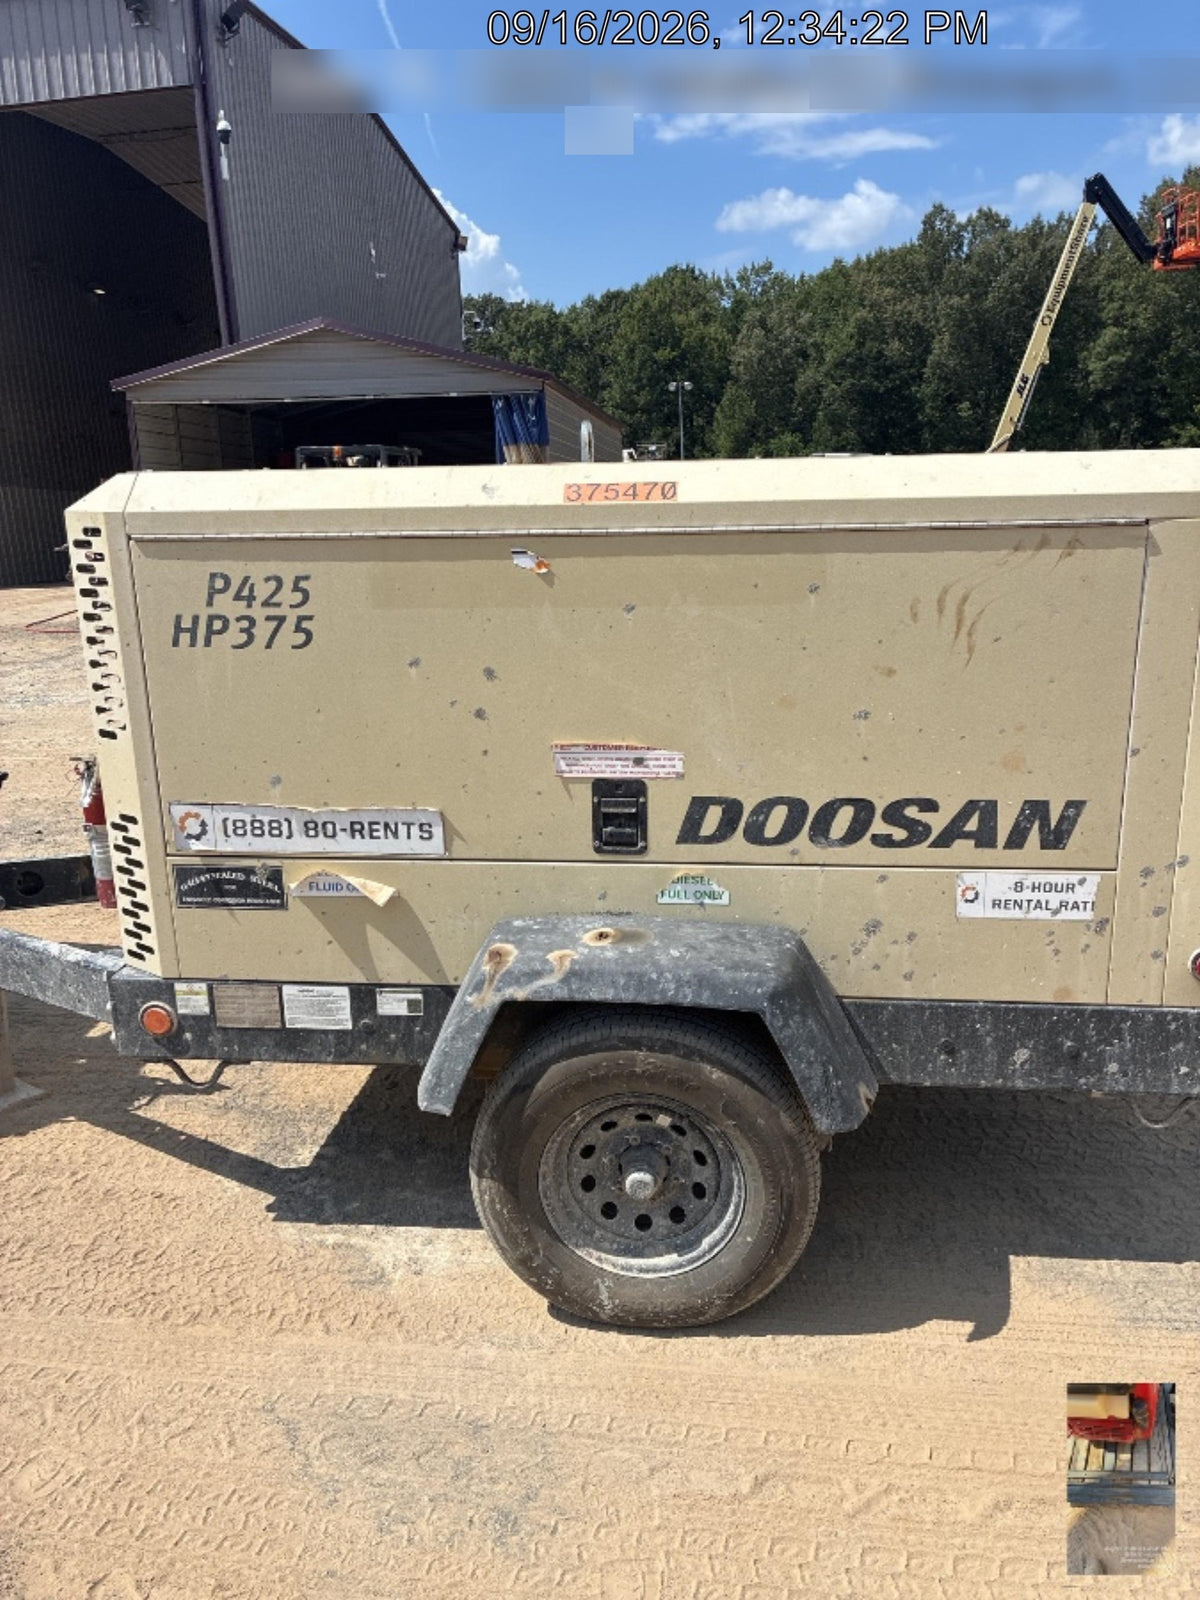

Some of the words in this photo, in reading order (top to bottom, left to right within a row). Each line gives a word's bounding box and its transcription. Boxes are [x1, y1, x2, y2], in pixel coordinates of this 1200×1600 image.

[566, 482, 677, 502] 375470
[206, 572, 312, 608] P425
[172, 614, 315, 650] HP375
[303, 819, 434, 841] 80-RENTS
[675, 795, 1089, 850] DOOSAN
[308, 881, 344, 892] FLUID
[693, 889, 725, 900] ONLY
[1013, 881, 1077, 894] 8-HOUR
[991, 898, 1053, 912] RENTAL
